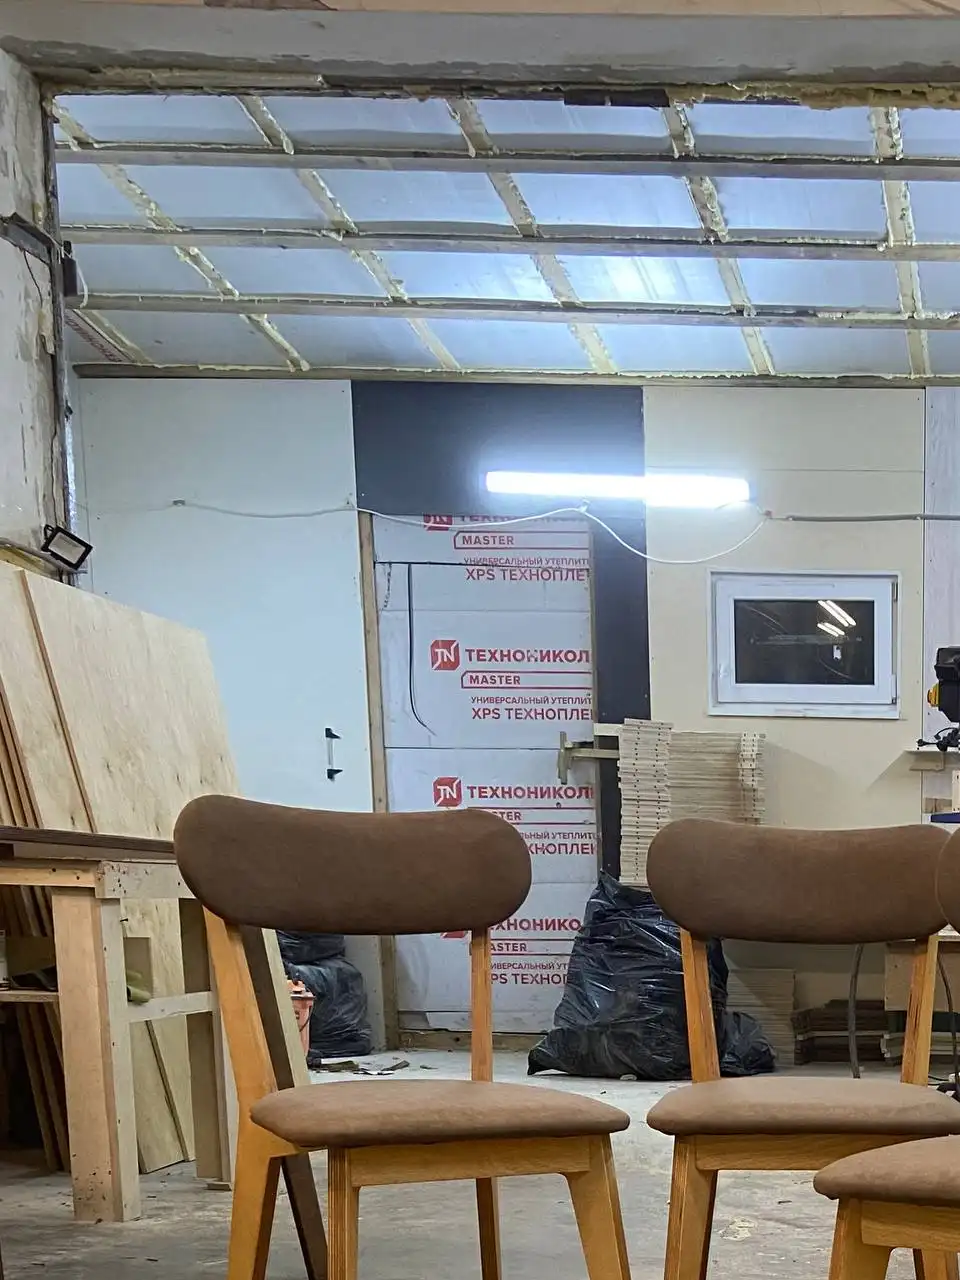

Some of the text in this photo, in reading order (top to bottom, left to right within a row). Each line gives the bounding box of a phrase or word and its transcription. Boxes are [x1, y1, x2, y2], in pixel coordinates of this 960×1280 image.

[462, 535, 515, 546] MASTER
[466, 568, 589, 582] XPS ТЕХНОПЛЕ
[469, 675, 521, 685] MASTER
[471, 695, 550, 704] УНИВЕРСАЛЬНЫЙ
[472, 708, 593, 721] XPS ТЕХНОПЛЕ
